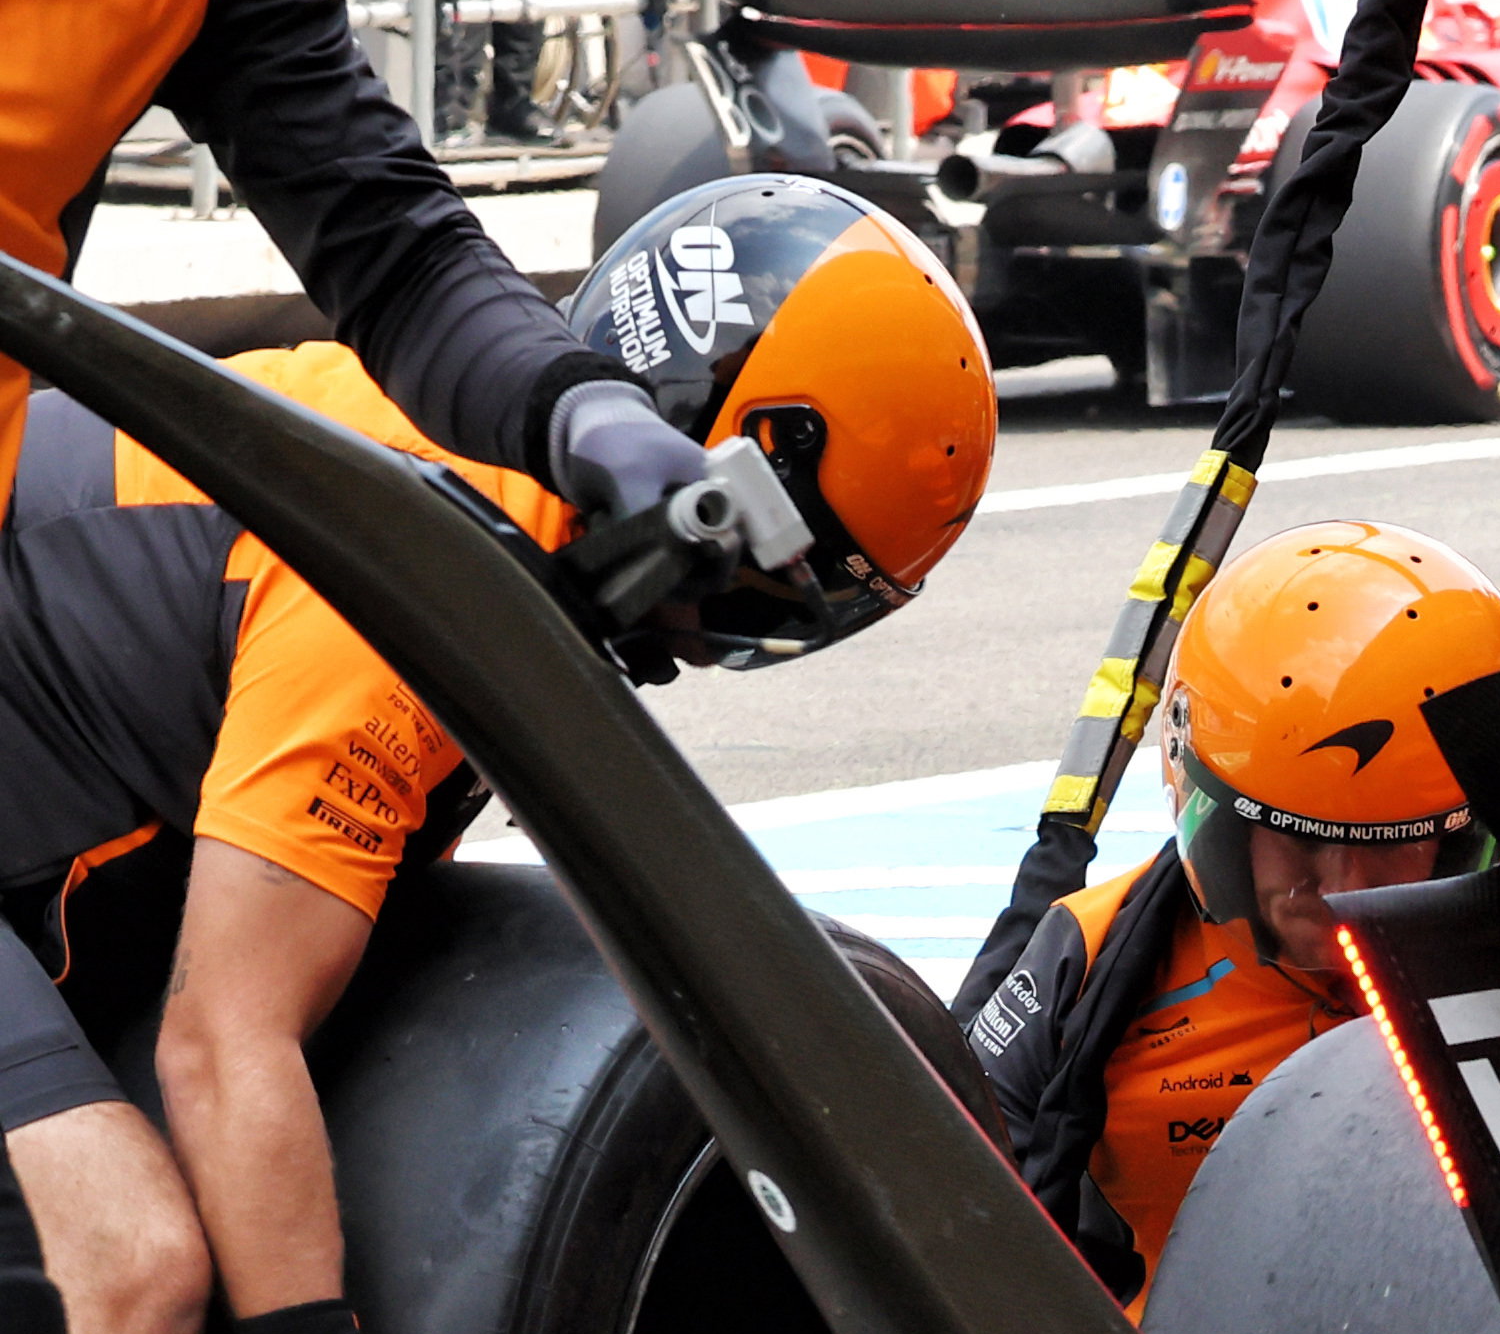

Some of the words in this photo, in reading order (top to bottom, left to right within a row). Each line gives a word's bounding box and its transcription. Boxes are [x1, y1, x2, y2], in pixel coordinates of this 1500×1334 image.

[670, 226, 755, 325] ON
[609, 264, 649, 374] NUTRITION
[628, 250, 672, 367] OPTIMUM
[325, 760, 398, 825] FxPro
[1234, 797, 1262, 819] ON
[1270, 811, 1344, 838] OPTIMUM
[1350, 821, 1434, 840] NUTRITION
[307, 796, 382, 855] PIRELLI
[984, 1038, 1004, 1057] STAY
[1159, 1072, 1224, 1094] Android
